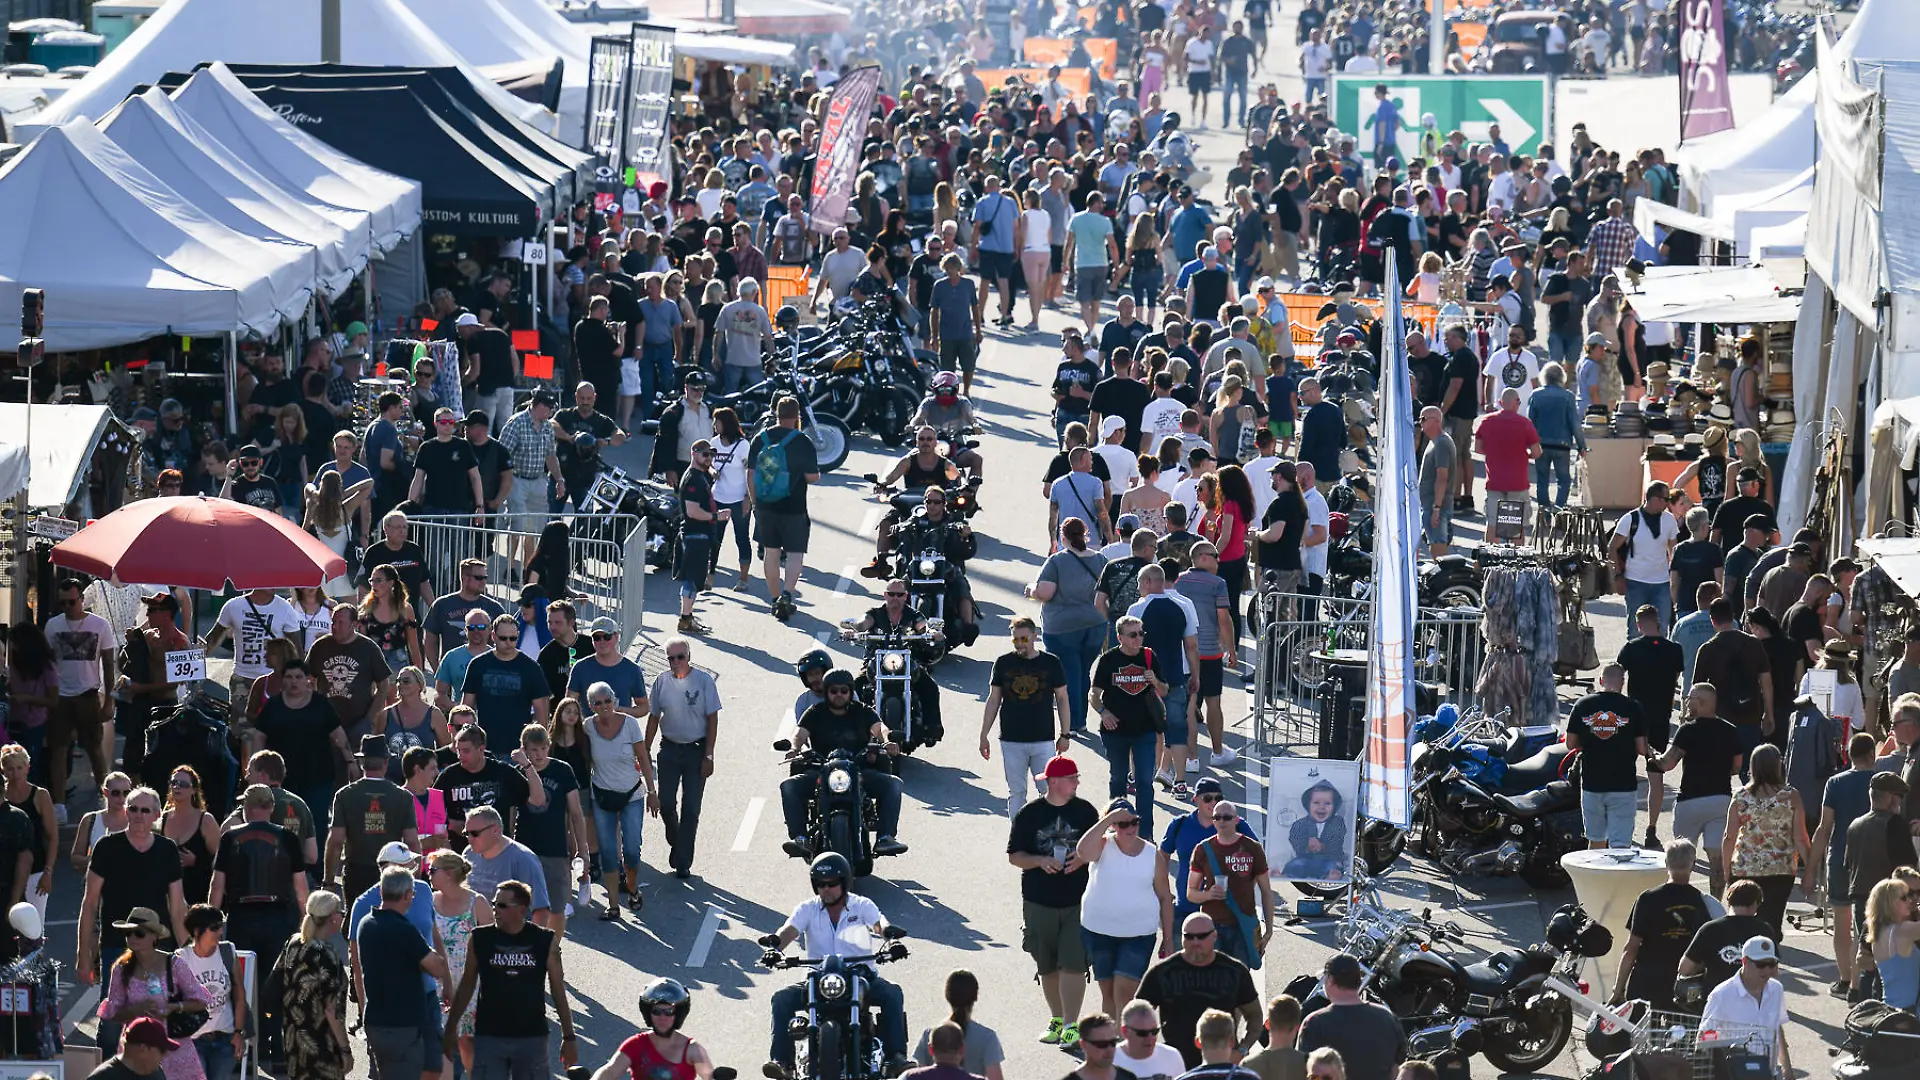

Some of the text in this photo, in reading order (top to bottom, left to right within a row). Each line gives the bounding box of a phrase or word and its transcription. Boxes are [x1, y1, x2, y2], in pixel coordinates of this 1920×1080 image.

[422, 209, 519, 224] USTOM KULTURE
[531, 249, 543, 260] 80
[167, 653, 187, 663] Jeans
[323, 655, 360, 670] GASOLINE
[174, 662, 199, 677] 39,-
[1231, 863, 1249, 872] Club
[489, 958, 537, 967] DAVIDSON
[196, 970, 231, 990] ARLEY
